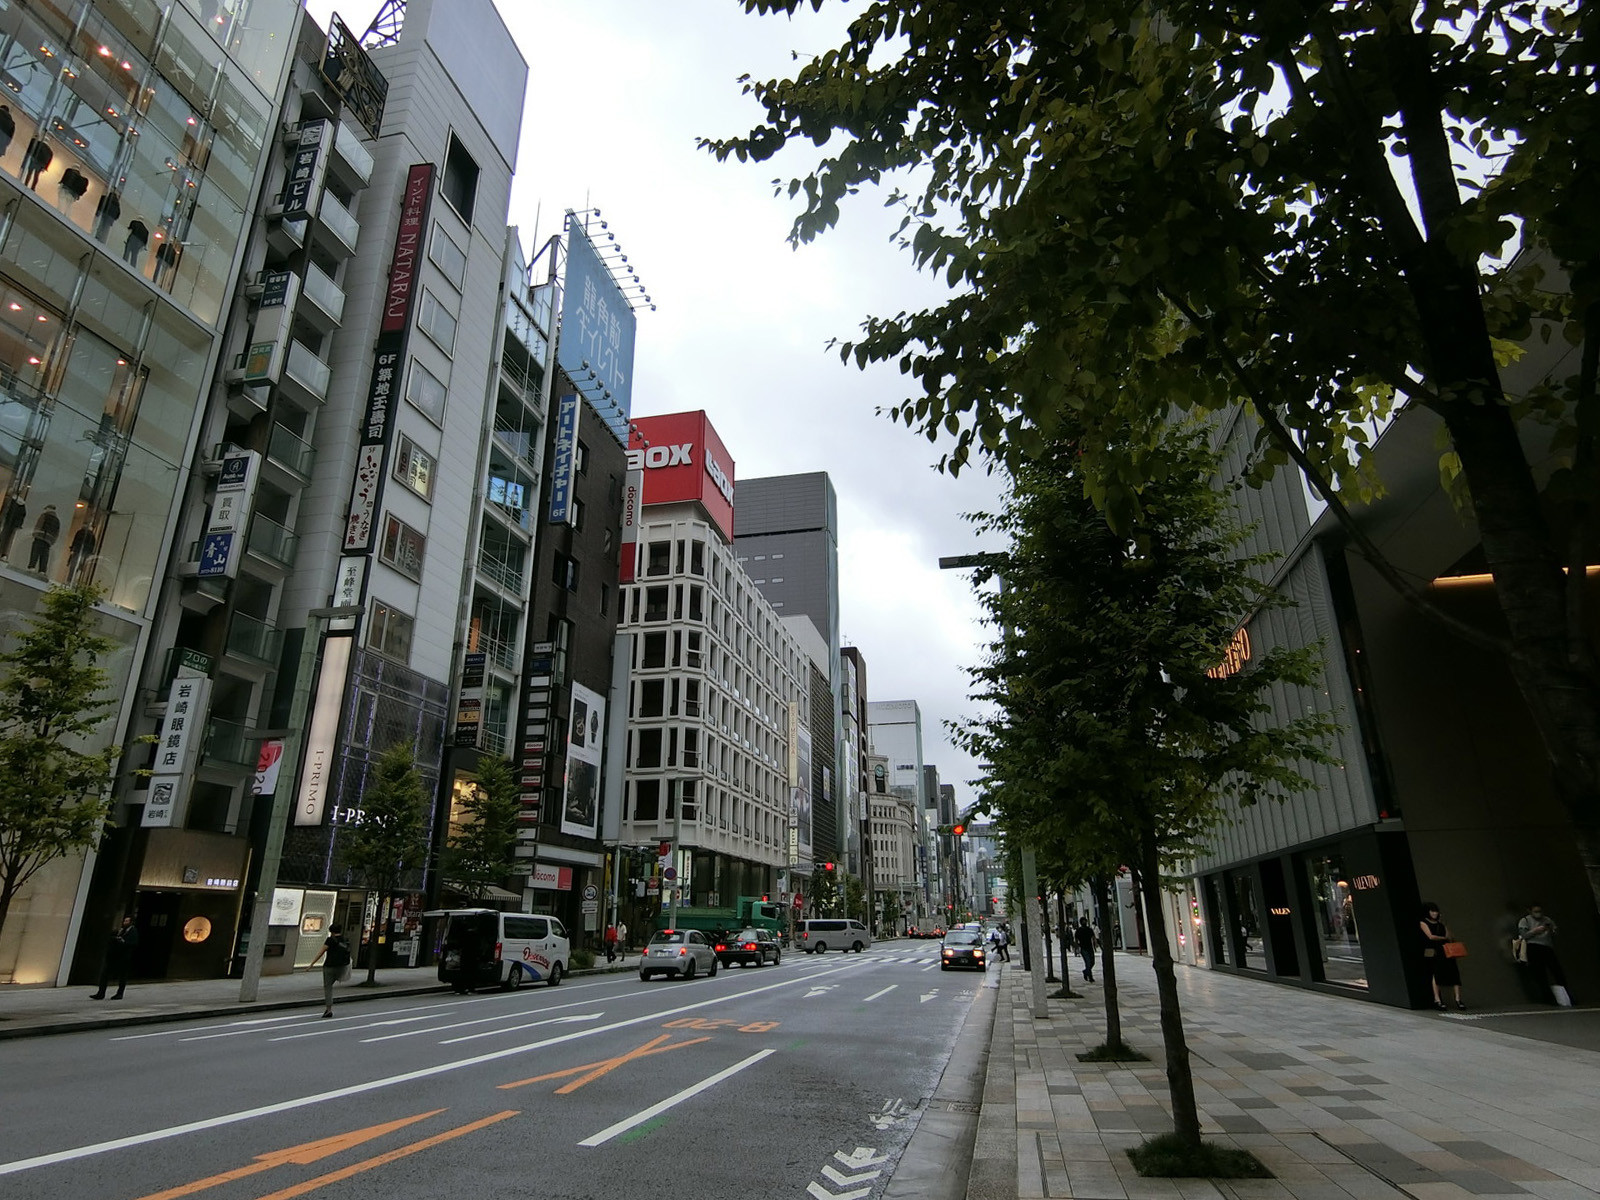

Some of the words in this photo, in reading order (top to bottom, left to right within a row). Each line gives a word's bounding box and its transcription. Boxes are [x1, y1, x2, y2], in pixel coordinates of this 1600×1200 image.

[287, 152, 314, 212] 岩崎ビル
[404, 177, 425, 227] インド料理
[387, 232, 418, 318] NATARAJ
[583, 275, 622, 354] 龍角散
[378, 353, 397, 365] 6F
[575, 306, 625, 390] ダイレクト
[554, 401, 576, 503] アートネイチャー
[218, 497, 234, 521] 買取
[358, 508, 371, 541] うなぎ
[552, 508, 566, 517] 6F
[625, 485, 637, 527] docomo
[205, 542, 226, 566] 青山
[185, 651, 208, 665] プロの
[162, 684, 192, 766] 岩崎眼鏡店
[304, 750, 325, 816] I-PRIMO
[147, 809, 164, 820] 岩崎
[661, 1017, 782, 1033] 8-20
